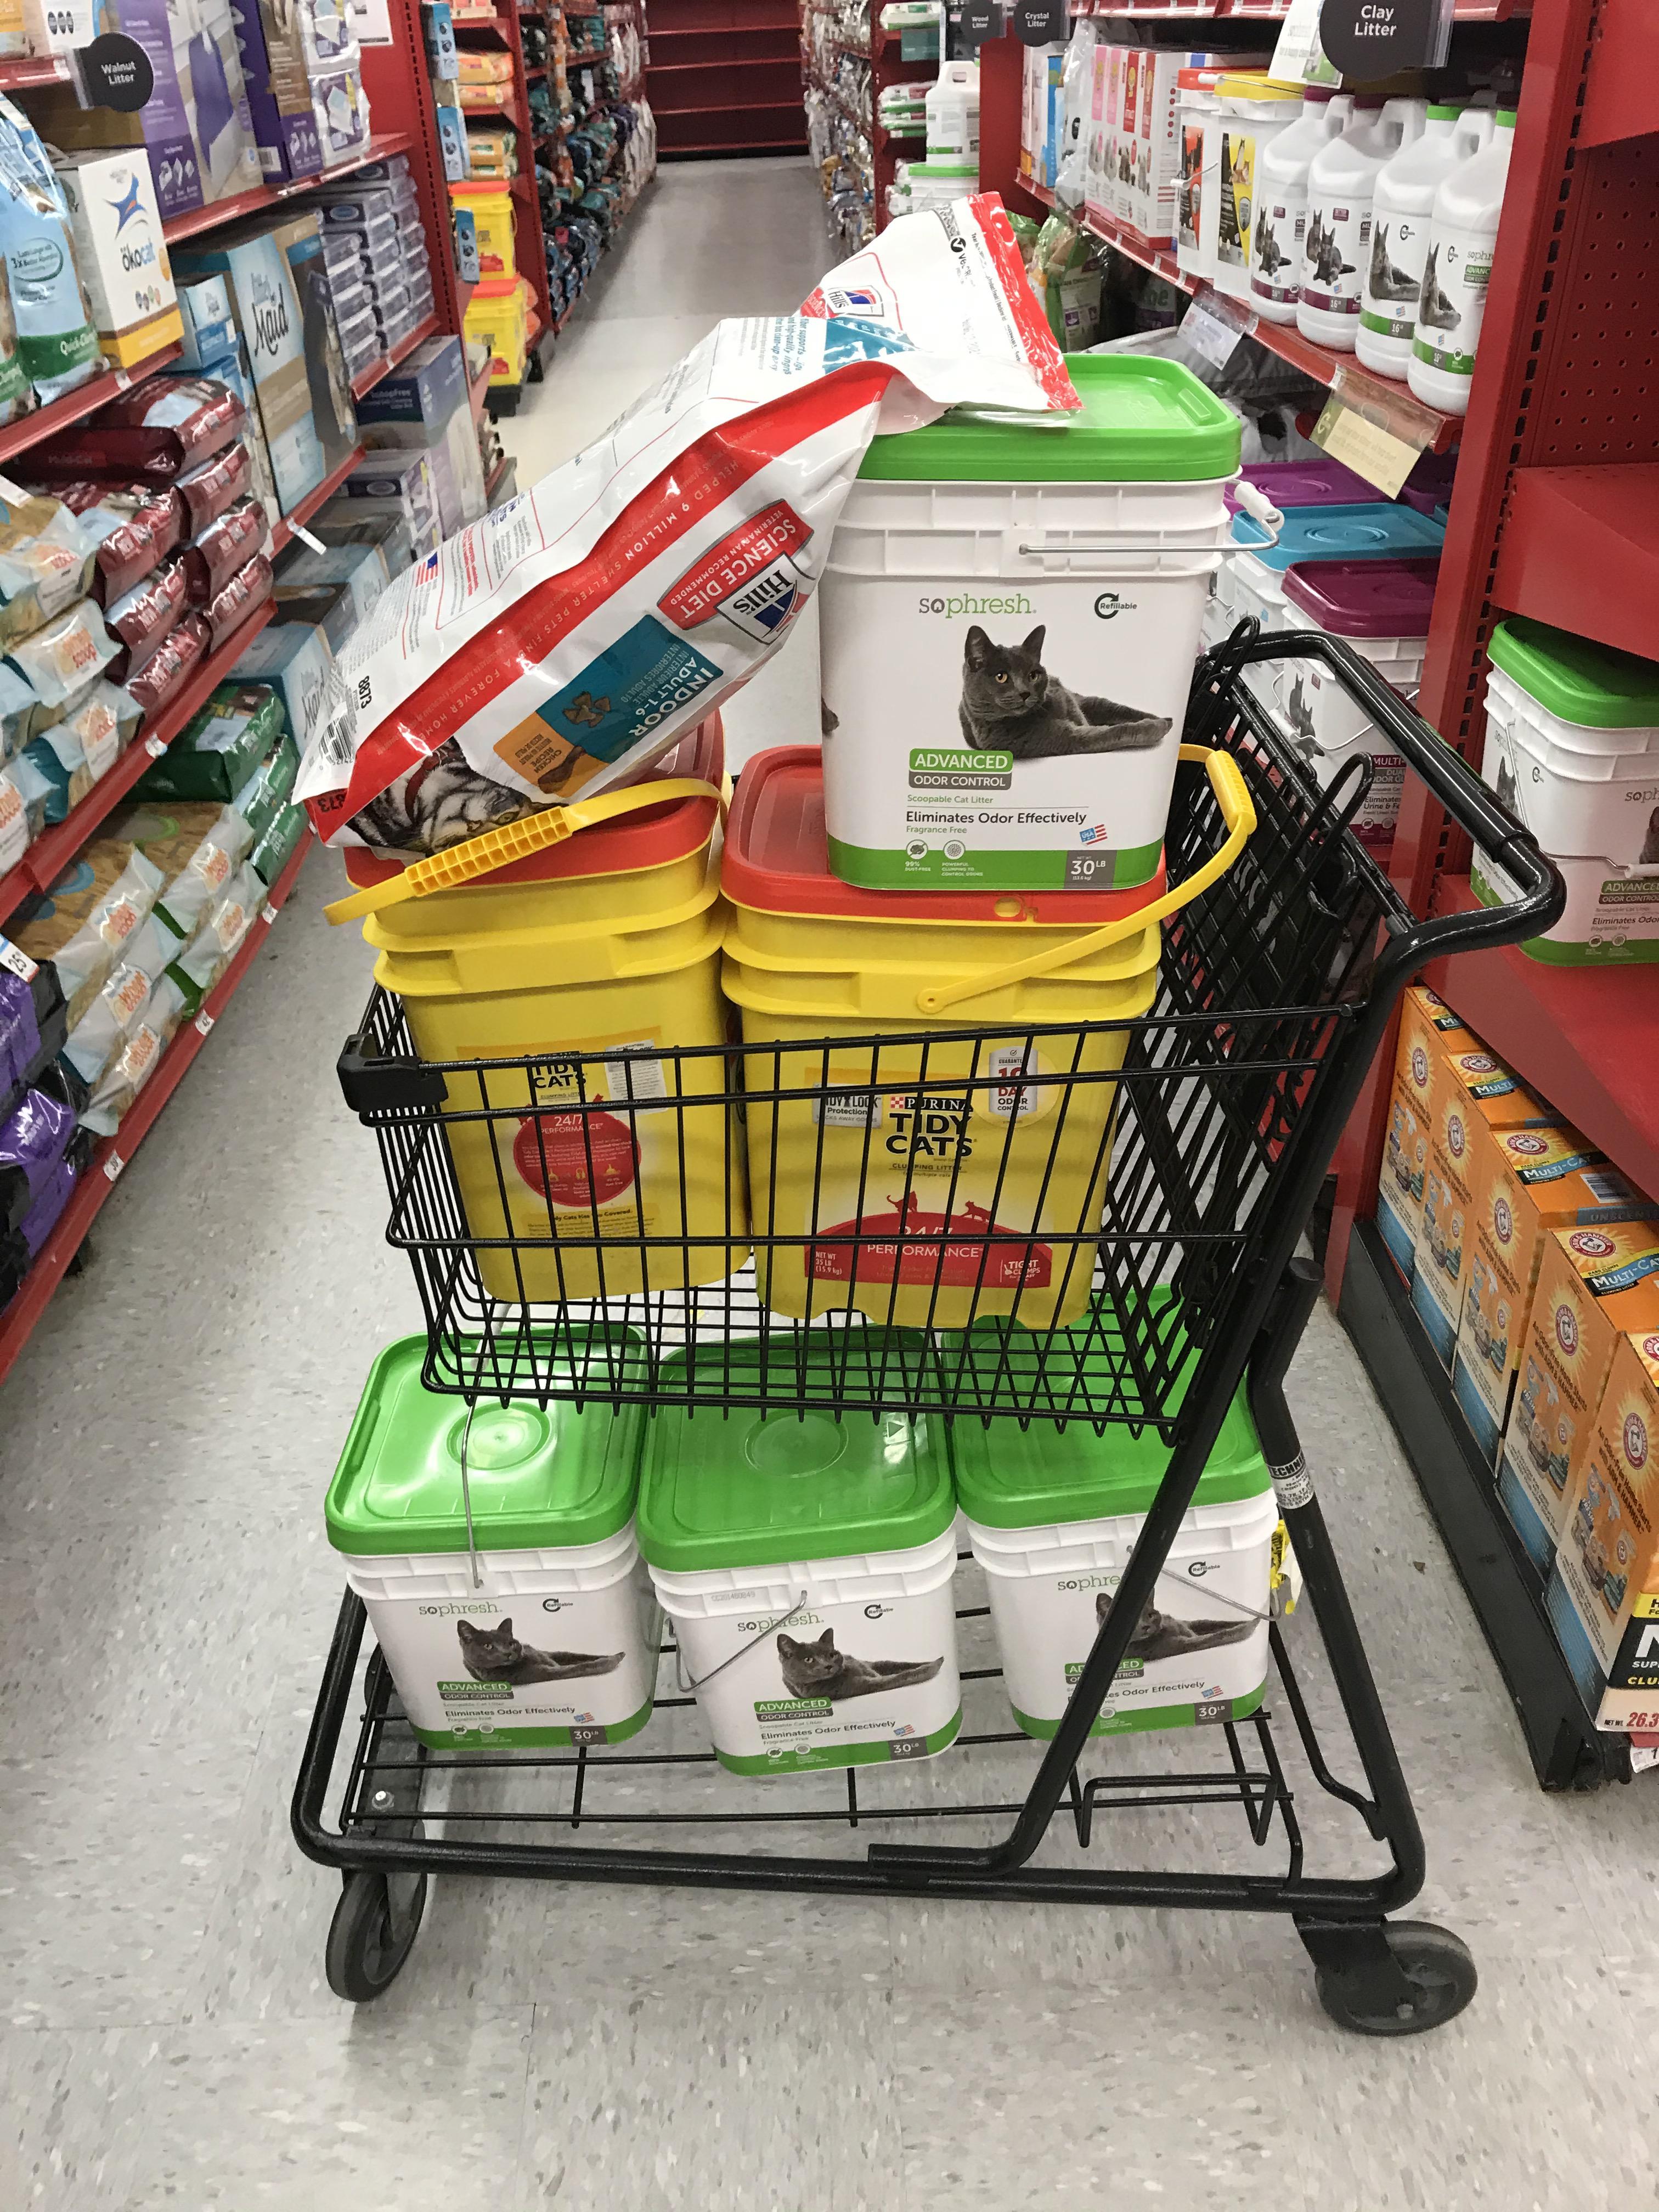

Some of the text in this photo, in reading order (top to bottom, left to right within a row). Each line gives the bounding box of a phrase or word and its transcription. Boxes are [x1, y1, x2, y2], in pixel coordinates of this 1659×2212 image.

[1025, 12, 1049, 20] Crystal
[1361, 5, 1394, 21] Clay
[1355, 21, 1397, 37] Litter
[101, 61, 136, 74] Walnut
[108, 74, 134, 85] Litter
[121, 238, 156, 272] ökocat
[1392, 324, 1400, 332] 16
[798, 331, 807, 355] supports
[695, 460, 739, 500] HELPED
[681, 502, 690, 511] 9
[624, 512, 678, 561] MILLION
[680, 518, 797, 620] SCIENCE DIET
[572, 561, 622, 607] SHELTER
[670, 553, 729, 606] RECOMMENDED
[733, 569, 795, 615] Hill's
[918, 593, 1032, 619] sophresh
[1100, 602, 1138, 610] Refillable
[544, 606, 571, 634] PETS
[503, 658, 511, 668] A
[358, 675, 372, 709] 8873
[451, 669, 500, 714] FOREVER
[636, 656, 697, 716] ADULT 1-6
[629, 667, 714, 738] INDOOR
[419, 712, 448, 742] HOME
[530, 747, 554, 767] RECIPE
[534, 749, 562, 774] CHICKEN
[914, 754, 1008, 769] ADVANCED
[913, 775, 1006, 787] ODOR CONTROL
[907, 794, 994, 805] Scoopable Cat Litter
[1624, 787, 1658, 804] soph
[906, 811, 1087, 825] Eliminates Odor Effectively
[906, 826, 947, 834] Fragrance
[1081, 831, 1094, 840] USA
[1070, 860, 1095, 876] 30
[1592, 917, 1636, 925] Eliminates
[534, 1073, 586, 1088] CATS
[998, 1086, 1028, 1097] DAY
[827, 1107, 868, 1115] Protection
[907, 1098, 972, 1111] PURINA
[554, 1114, 583, 1127] 24/7
[889, 1113, 972, 1135] TIDY
[541, 1123, 602, 1135] PERFORMACE
[885, 1135, 973, 1157] CATS
[827, 1252, 836, 1260] WT
[1008, 1260, 1039, 1269] TIGT
[1192, 1564, 1221, 1572] Refillable
[1058, 1573, 1121, 1592] sophre
[419, 1601, 498, 1617] sophresh
[738, 1612, 820, 1633] sophresh
[1069, 1659, 1140, 1674] ADCED
[442, 1683, 508, 1691] ADVANCED
[1122, 1680, 1205, 1697] Odor Effectively
[445, 1710, 494, 1718] Eliminates
[525, 1706, 575, 1716] Effectively
[759, 1700, 827, 1712] ADVANCED
[1199, 1706, 1217, 1717] 30
[788, 1711, 829, 1719] CONTROL
[573, 1730, 591, 1740] 30
[760, 1720, 896, 1740] Eliminates Odor Effectively
[893, 1743, 912, 1754] 30
